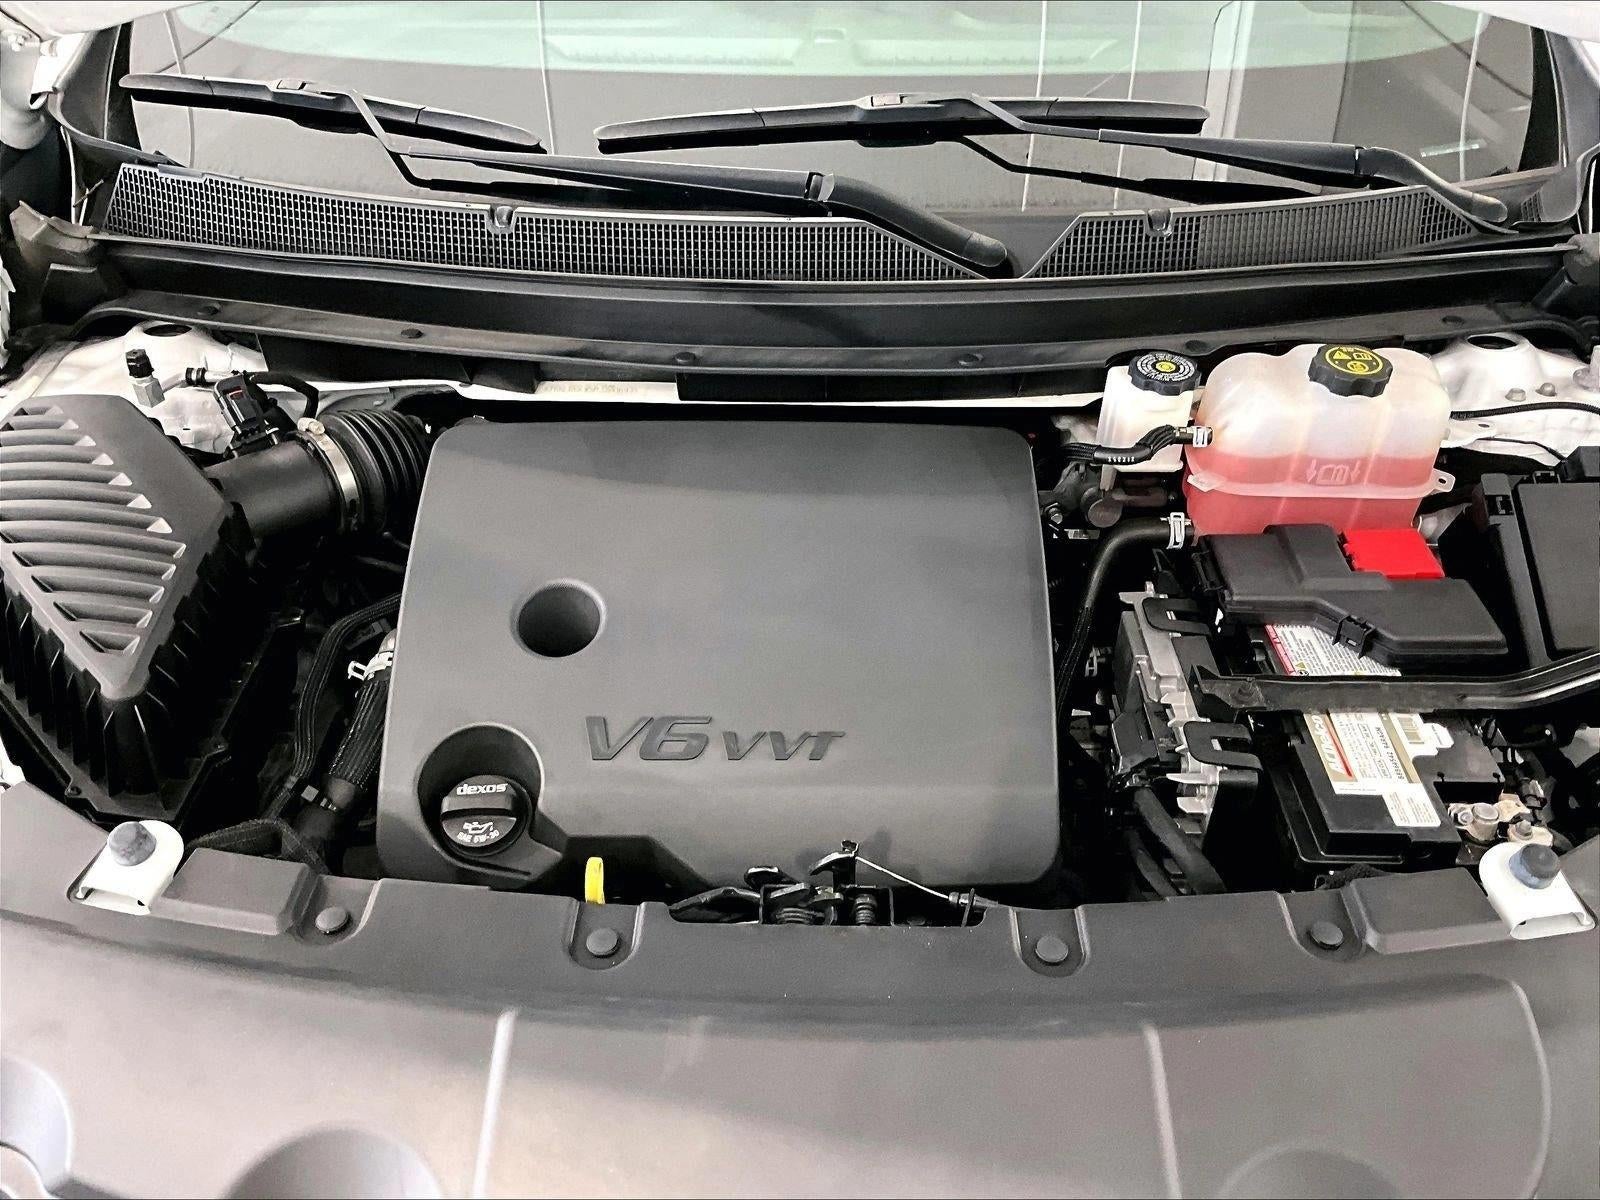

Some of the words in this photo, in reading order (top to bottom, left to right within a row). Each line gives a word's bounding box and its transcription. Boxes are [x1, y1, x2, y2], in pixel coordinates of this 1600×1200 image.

[585, 715, 712, 761] V6
[722, 730, 846, 761] VVT
[456, 783, 509, 796] dexos
